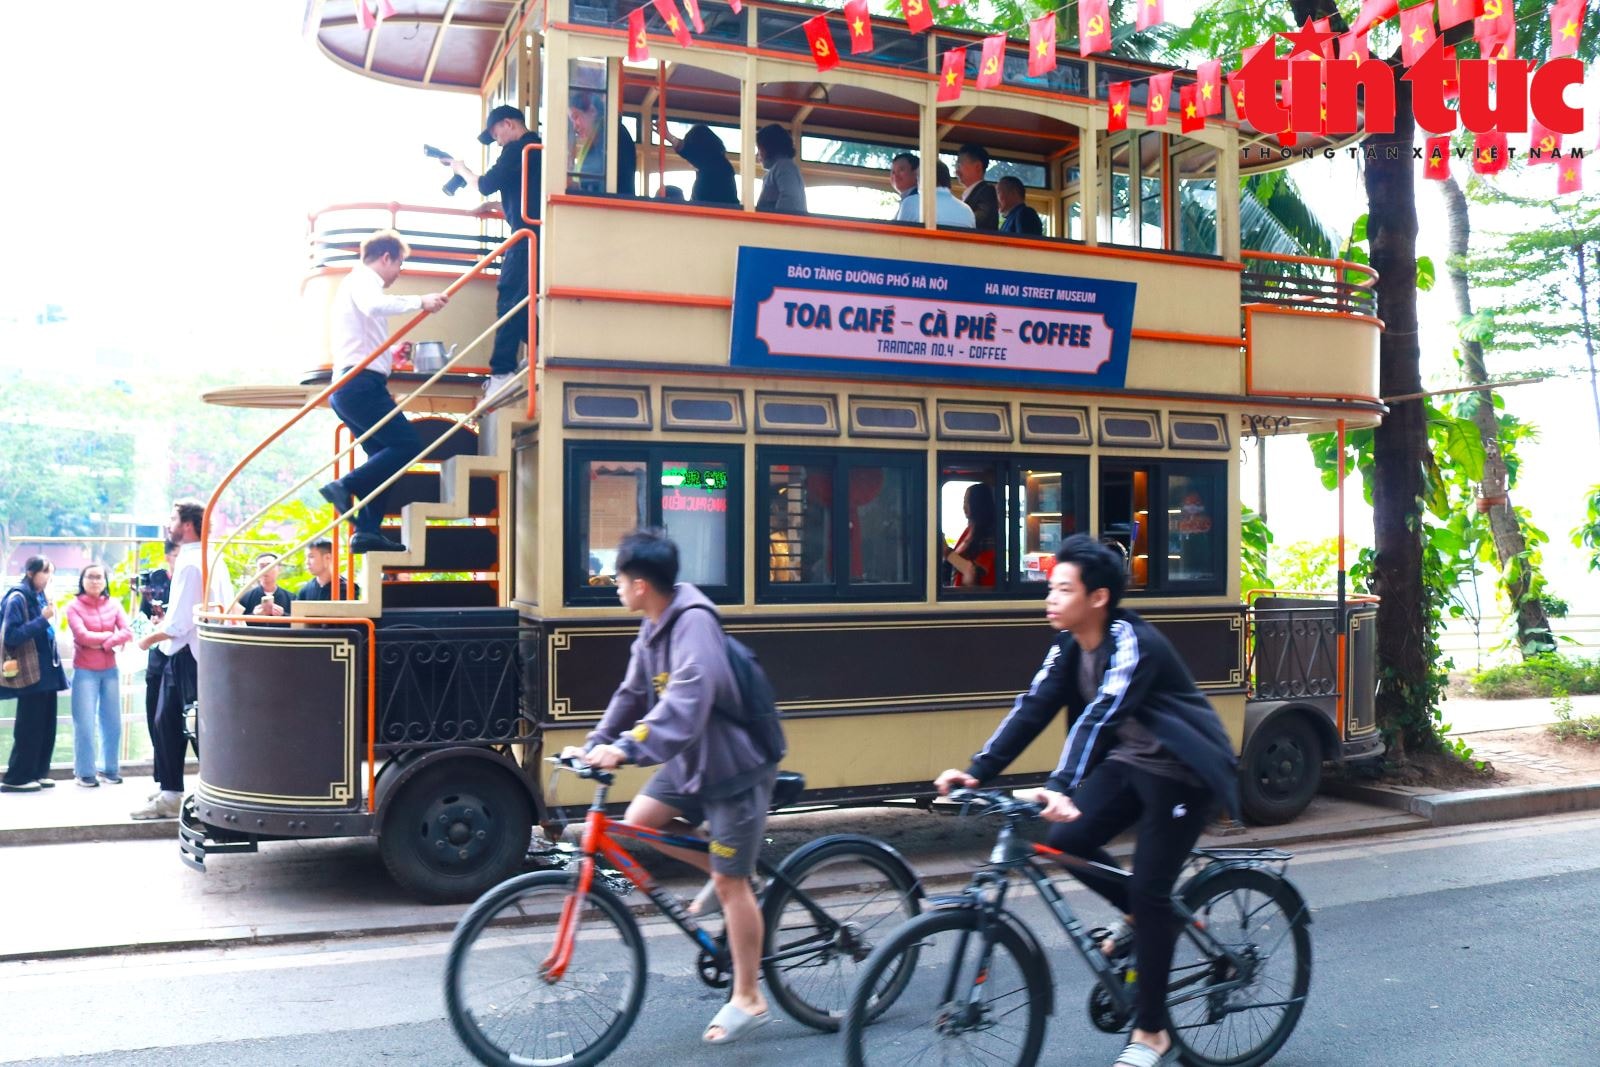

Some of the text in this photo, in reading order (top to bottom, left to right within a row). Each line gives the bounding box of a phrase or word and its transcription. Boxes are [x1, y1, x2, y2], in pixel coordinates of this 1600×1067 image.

[814, 266, 842, 281] TÀNG
[886, 272, 911, 287] PHỐ
[911, 275, 927, 289] HÀ
[929, 276, 948, 291] NỘI
[985, 282, 1097, 303] HA NOI STREET MUSEUM
[784, 301, 832, 330] TOA
[838, 305, 896, 335] CAFÉ
[919, 309, 949, 339] CÀ
[954, 312, 998, 342] PHÊ
[1018, 319, 1093, 348] COFFEE
[877, 339, 927, 355] TRAMCAR
[969, 345, 1008, 361] COFFEE
